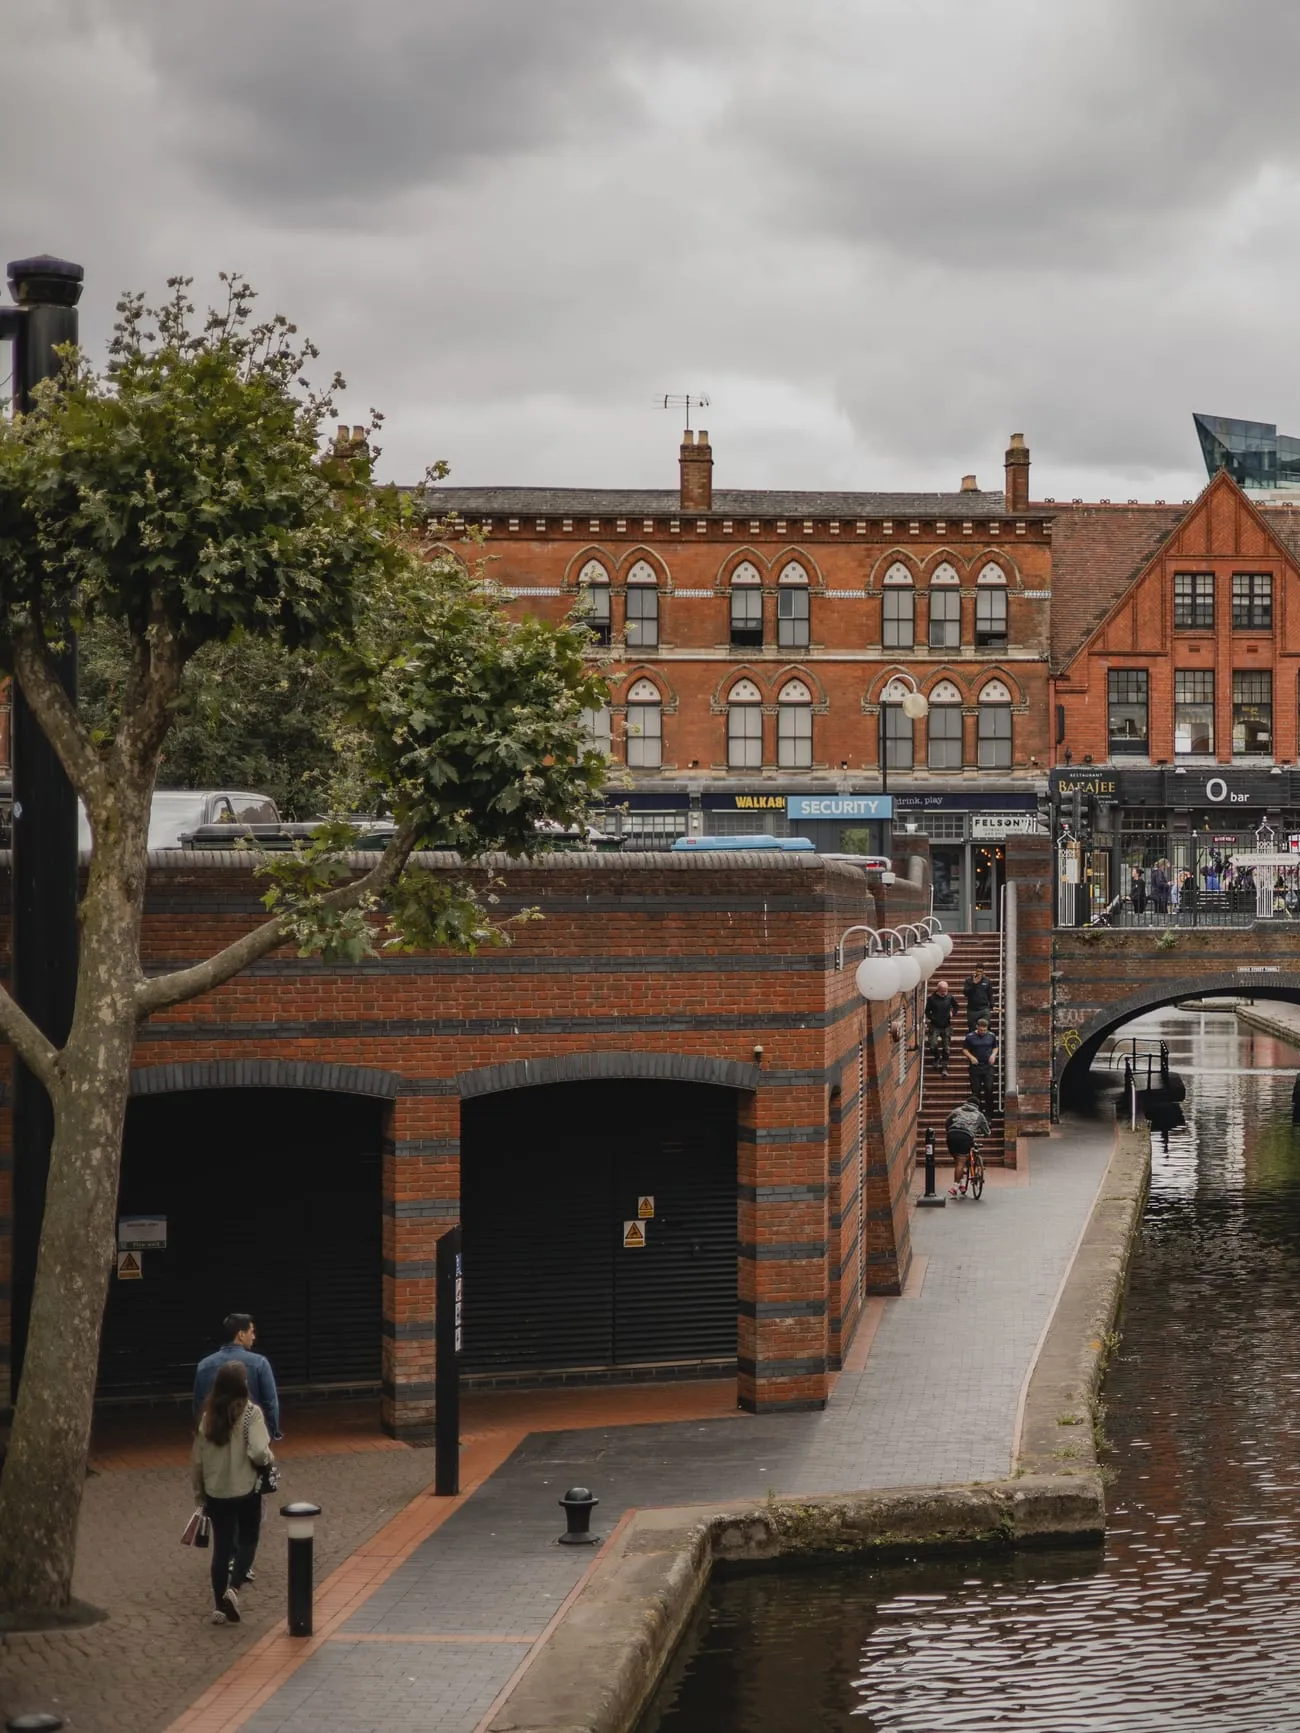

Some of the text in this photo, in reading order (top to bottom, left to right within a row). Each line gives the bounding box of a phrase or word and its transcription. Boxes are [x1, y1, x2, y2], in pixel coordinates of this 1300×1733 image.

[1206, 778, 1250, 802] O bar
[736, 796, 786, 808] WALKAB
[801, 800, 879, 814] SECURITY
[924, 796, 943, 805] play
